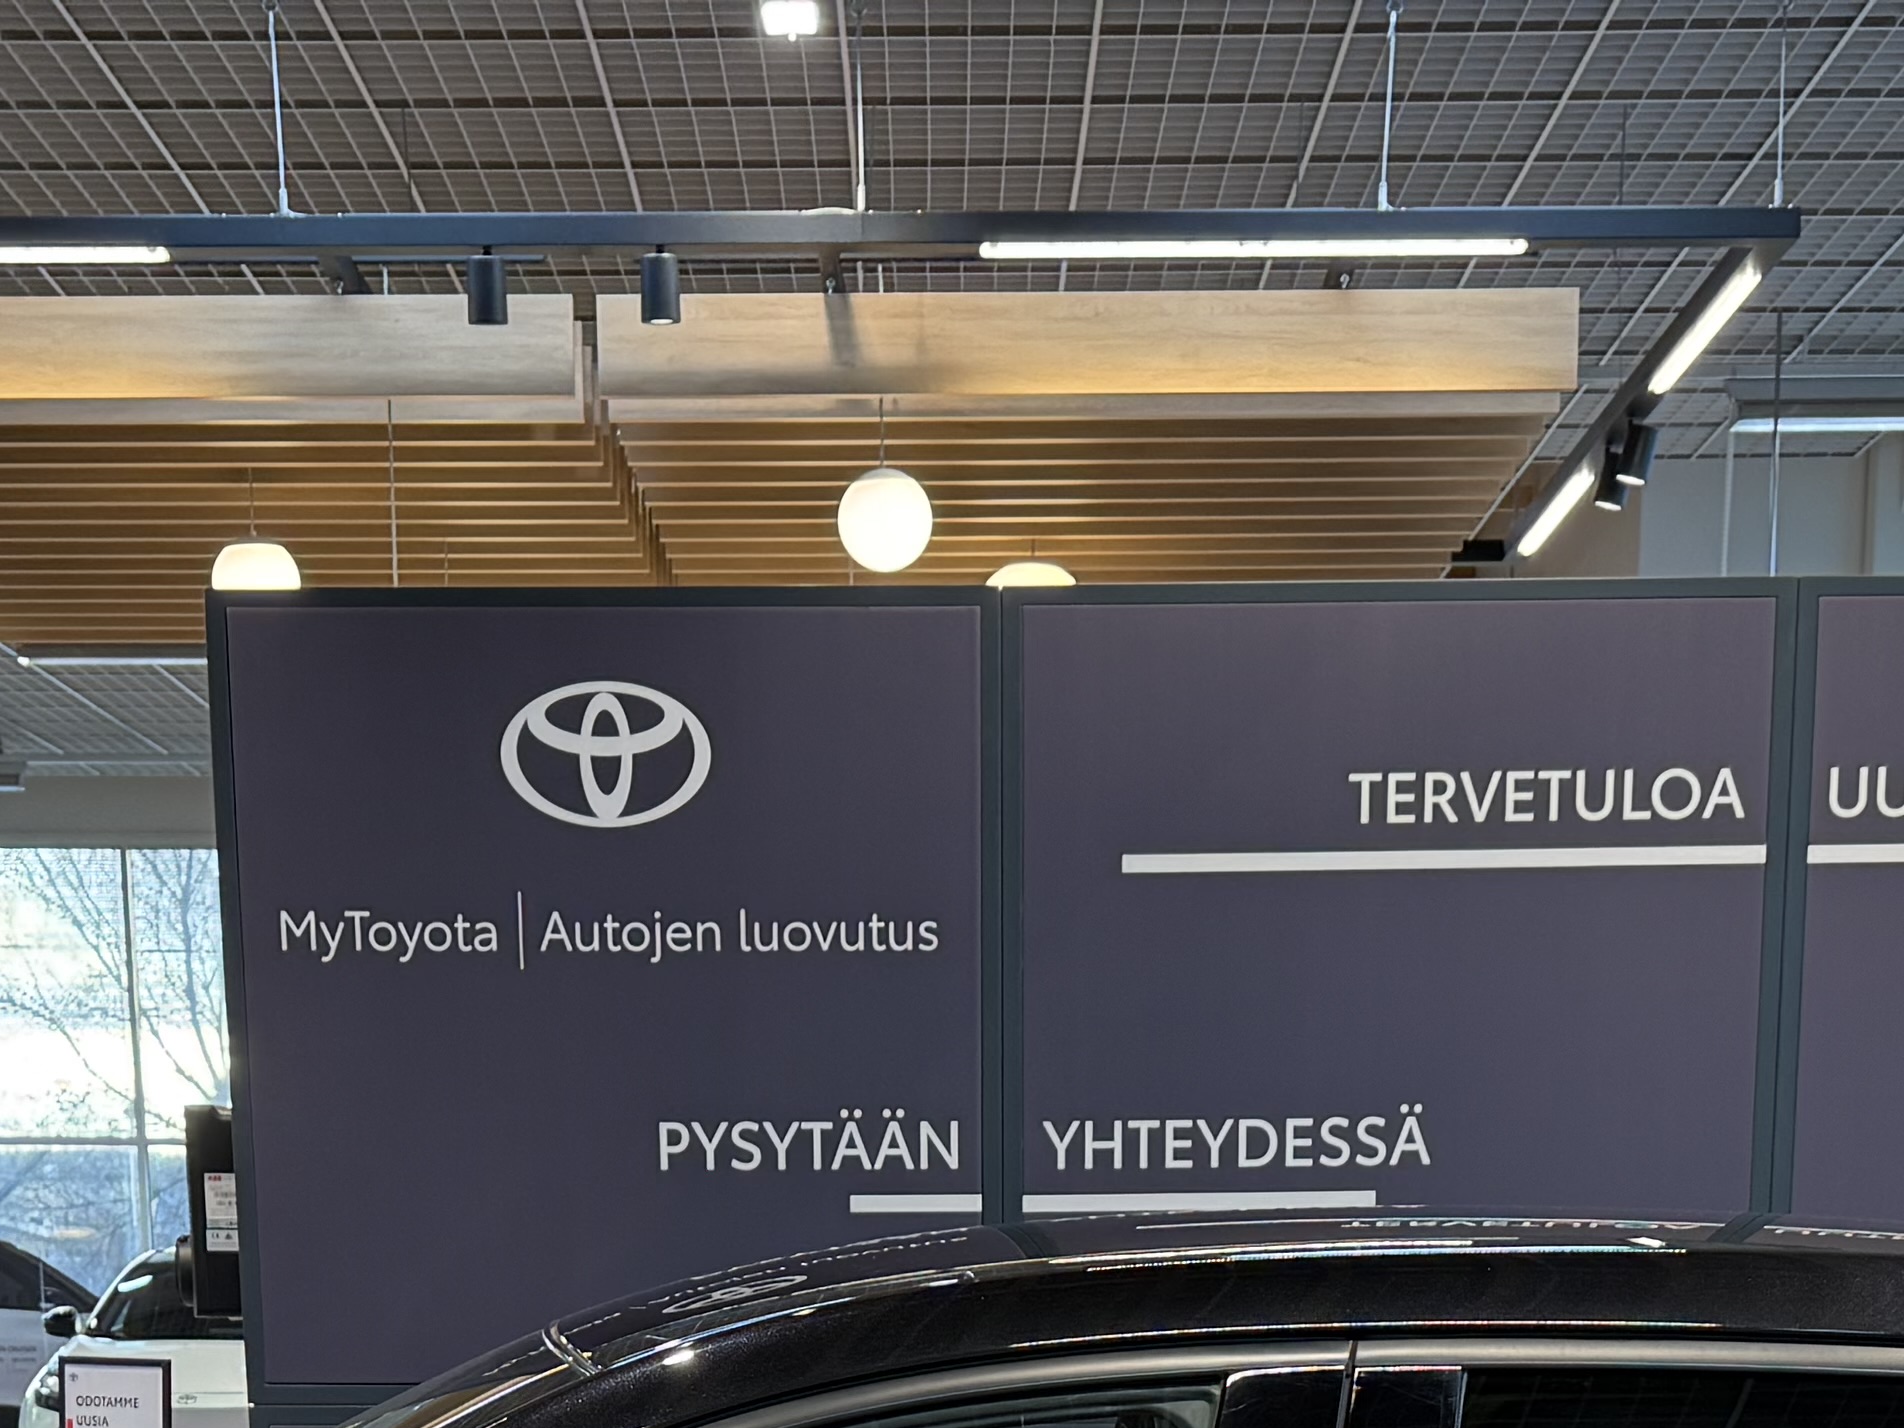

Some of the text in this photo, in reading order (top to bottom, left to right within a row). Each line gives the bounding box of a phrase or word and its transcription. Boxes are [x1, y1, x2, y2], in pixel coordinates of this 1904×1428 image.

[1348, 767, 1745, 824] TERVETULOA
[280, 908, 939, 964] MyToyota Autojen luovutus
[658, 1103, 1431, 1171] PYSYTÄÄN YHTEYDESSÄ
[75, 1395, 140, 1409] ODOTAMME
[76, 1415, 109, 1427] UUSIA
